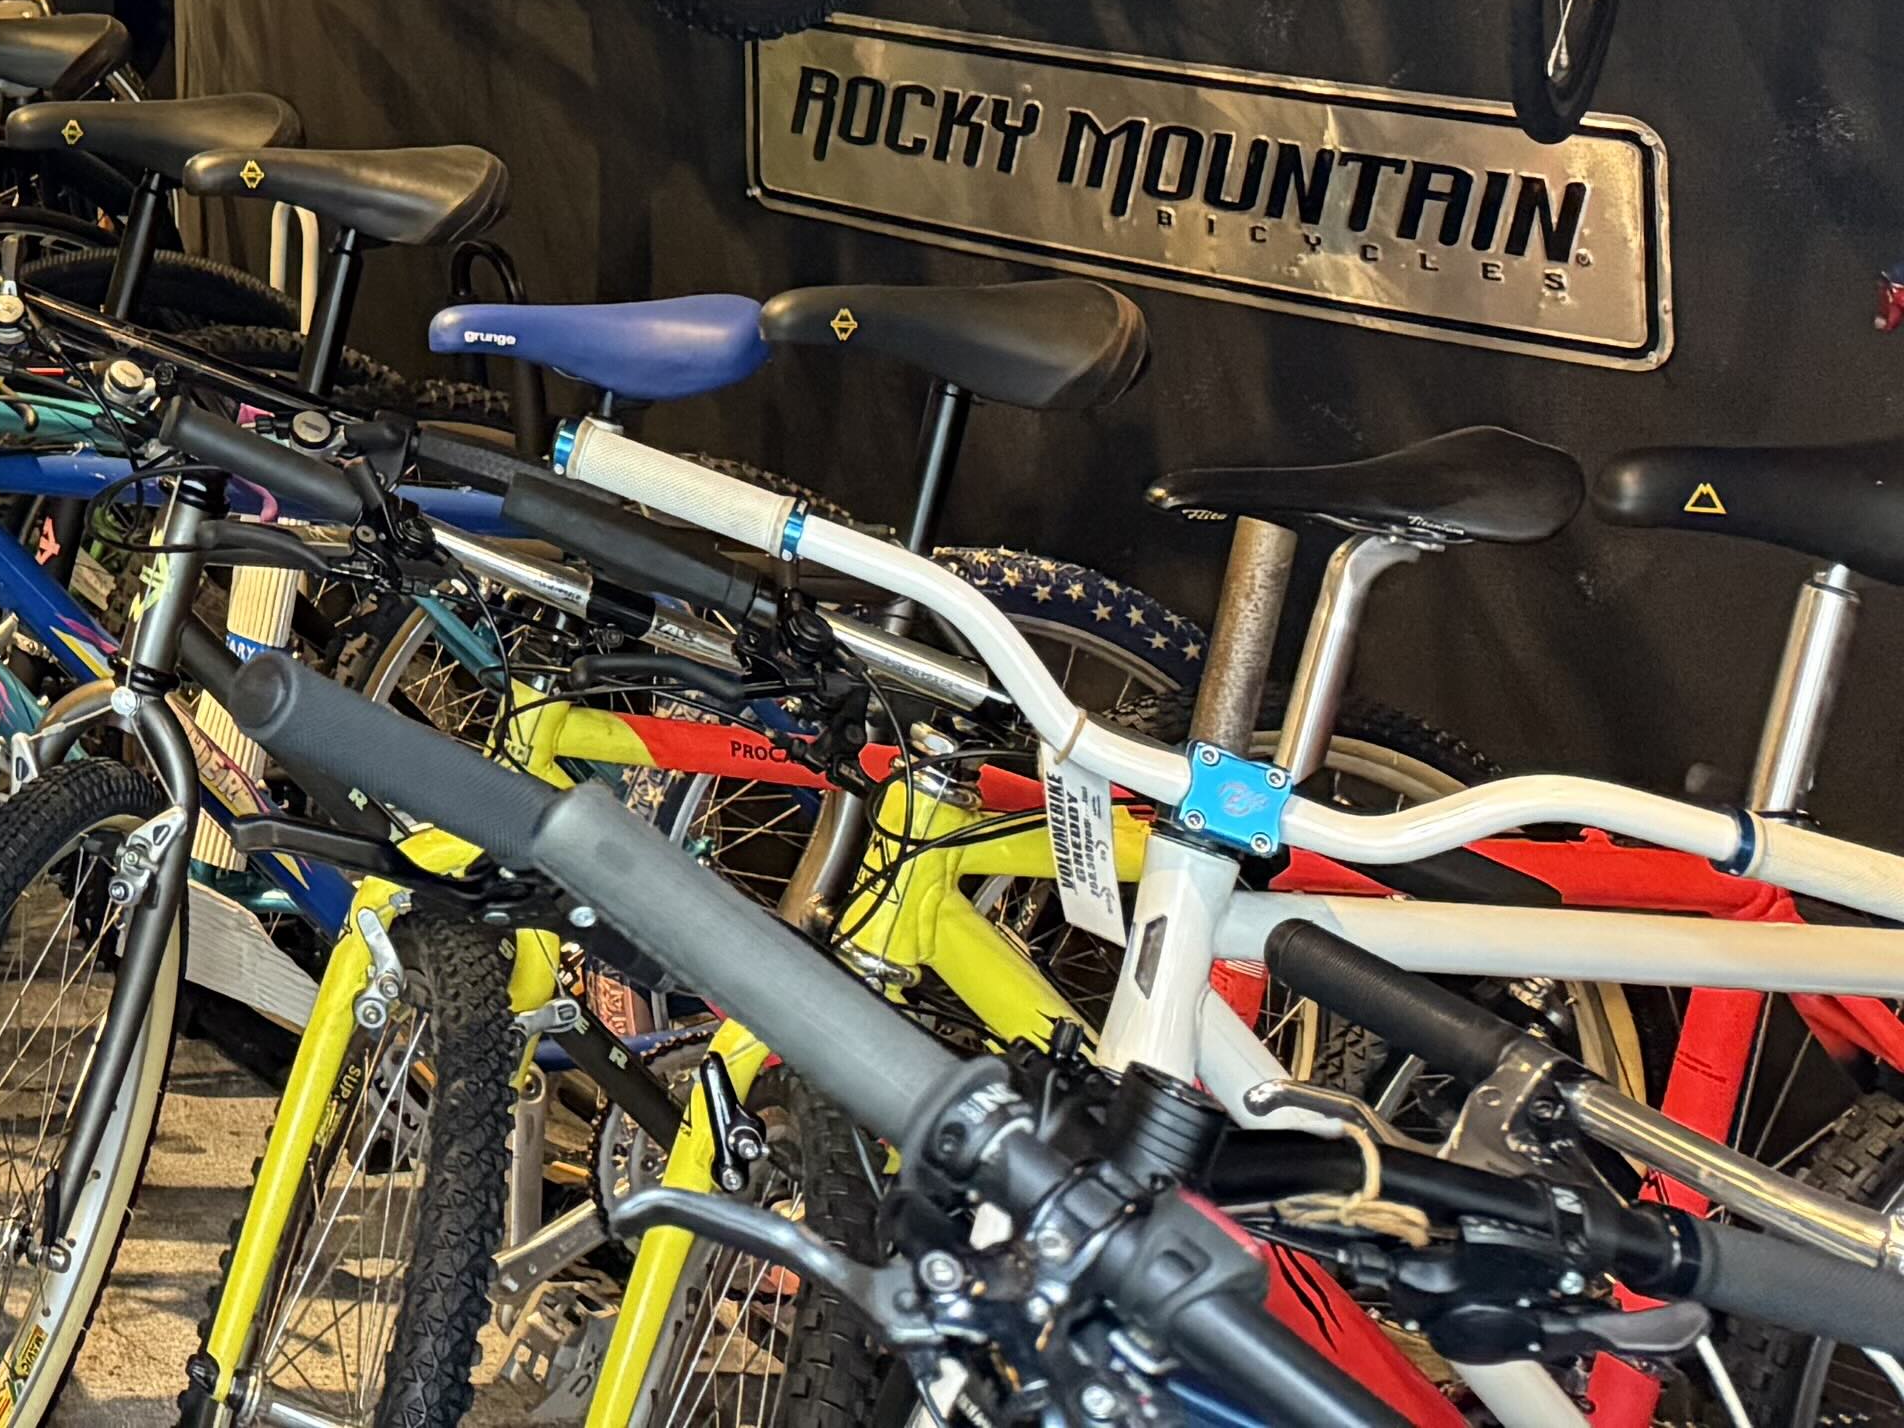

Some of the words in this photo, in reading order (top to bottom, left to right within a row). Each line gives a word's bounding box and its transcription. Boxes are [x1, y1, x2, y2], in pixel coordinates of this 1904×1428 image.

[791, 64, 1040, 167] ROCKY
[1056, 108, 1589, 263] MOUNTAIN
[1155, 207, 1567, 292] BICYCLES
[464, 330, 517, 346] grunge
[1044, 770, 1077, 894] VOLUMEBIKE
[1064, 790, 1090, 876] GREEDY
